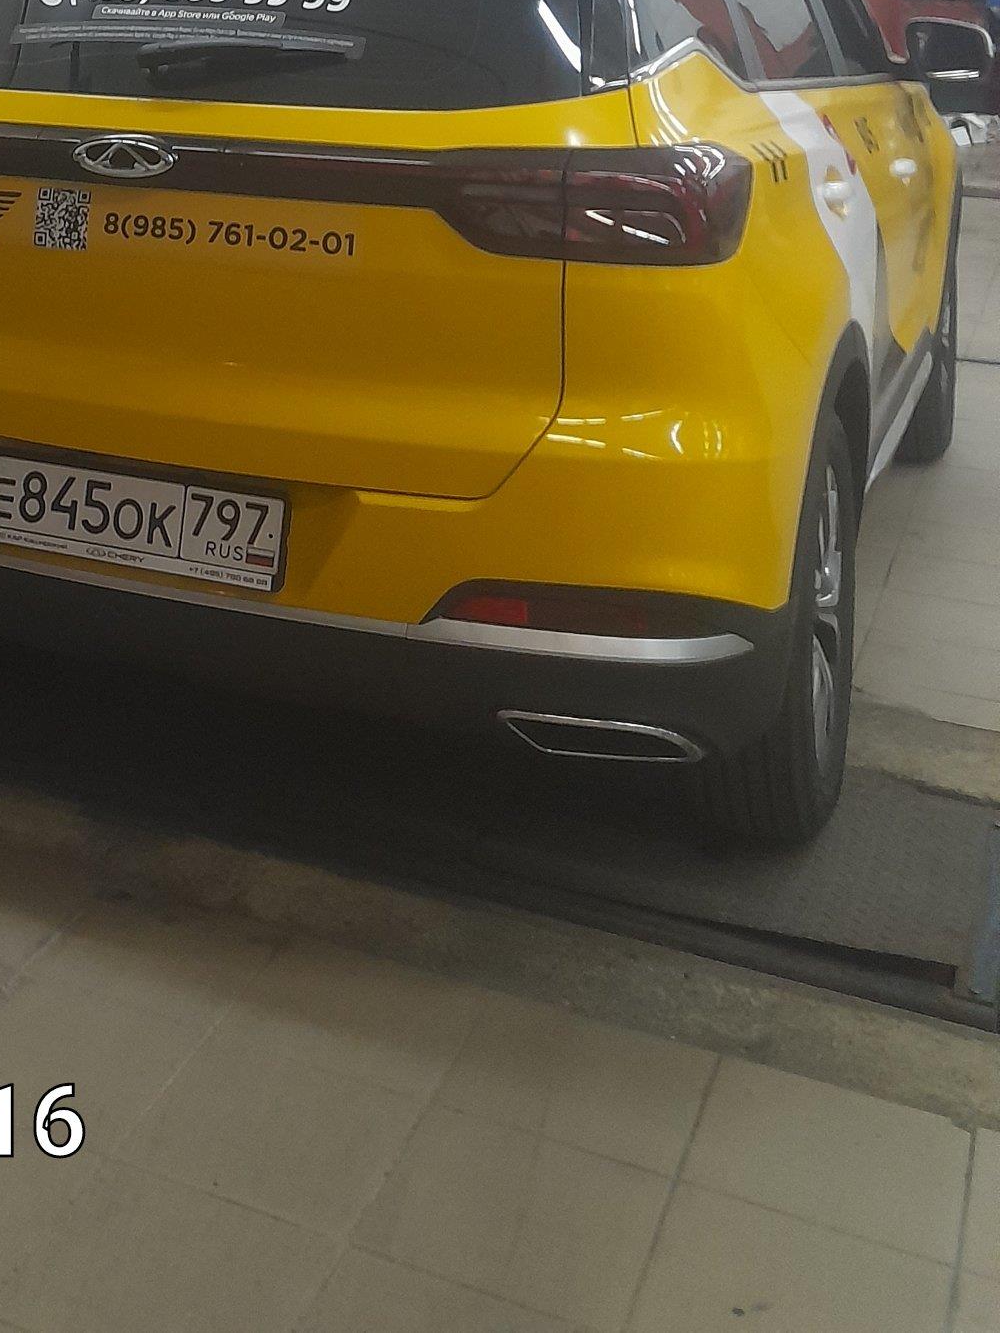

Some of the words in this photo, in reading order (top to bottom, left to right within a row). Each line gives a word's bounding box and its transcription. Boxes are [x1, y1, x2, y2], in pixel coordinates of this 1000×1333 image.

[101, 5, 150, 17] Скачивайте
[158, 9, 176, 19] App
[177, 9, 200, 19] Store
[202, 12, 220, 20] или
[221, 11, 254, 23] Google
[256, 13, 276, 24] Play
[103, 212, 197, 246] 8(985)
[207, 220, 356, 257] 761-02-01
[190, 493, 270, 547] 797
[107, 550, 145, 564] CHERY
[205, 540, 244, 562] RUS
